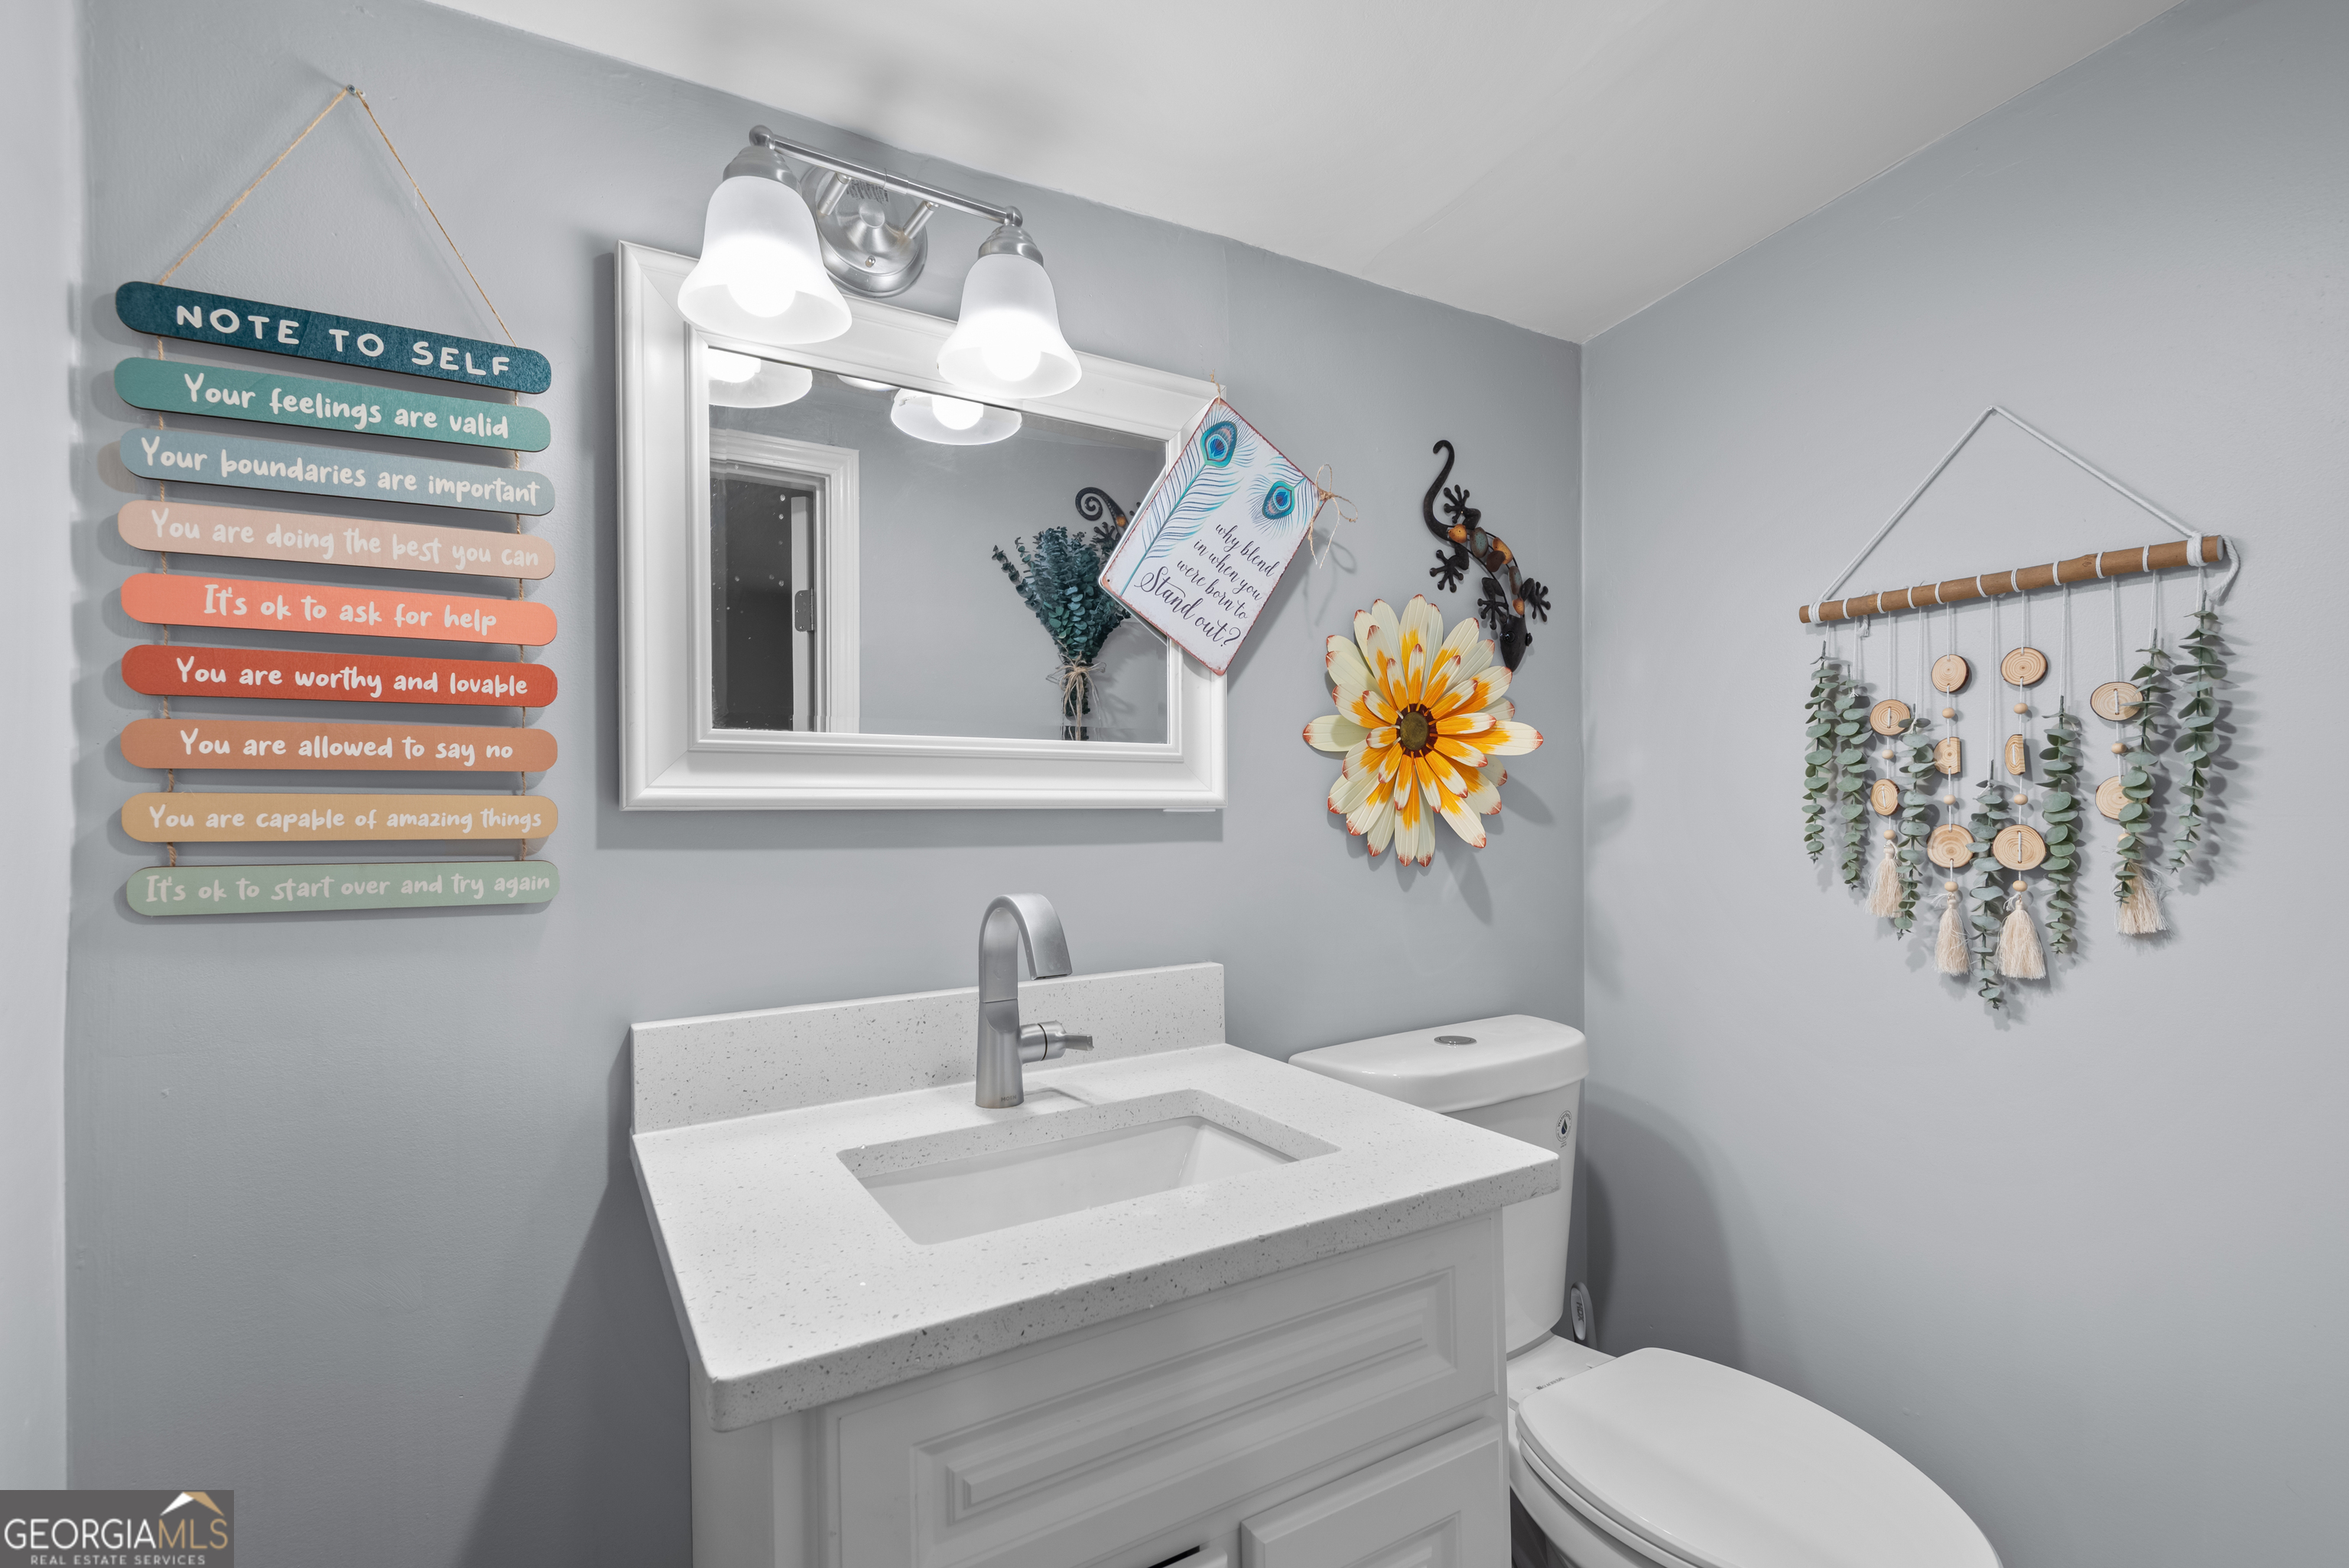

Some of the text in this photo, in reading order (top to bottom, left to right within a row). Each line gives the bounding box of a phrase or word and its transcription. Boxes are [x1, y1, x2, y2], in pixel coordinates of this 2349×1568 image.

[177, 305, 510, 376] NOTE TO SELF
[184, 372, 508, 439] Your feelings are valid
[141, 437, 540, 505] Your boundaries are important
[151, 508, 538, 570] You are doing the best you can
[1215, 524, 1280, 577] why blend
[1177, 560, 1248, 618] were born to
[1194, 539, 1263, 601] in when you
[203, 583, 497, 636] It's ok to ask for help
[1134, 566, 1241, 647] Stand out?
[176, 656, 528, 698] You are worthy and lovable
[180, 728, 513, 767] You are allowed to say no
[149, 804, 541, 833] You are capable of amazing things
[145, 873, 550, 903] It's ok to start over and try again
[1576, 1302, 1584, 1322] HDX
